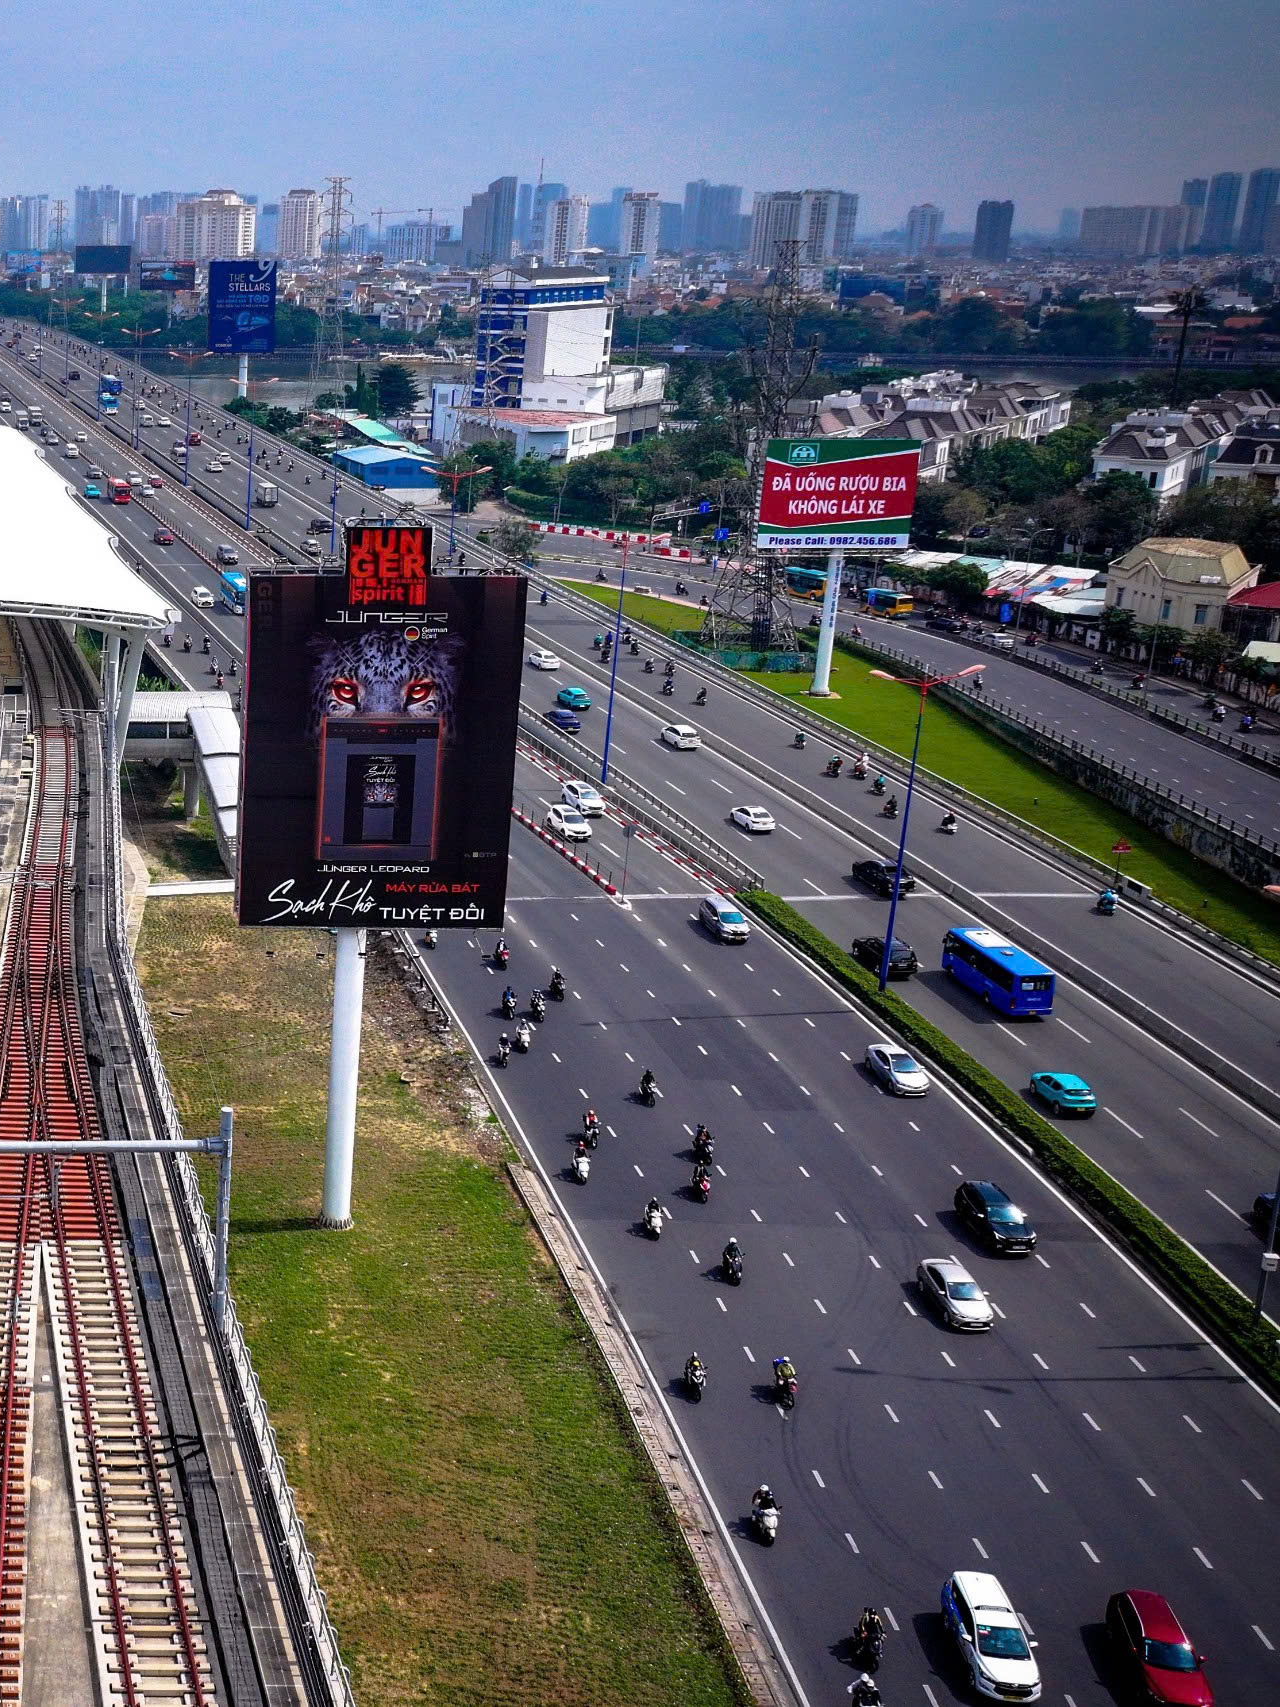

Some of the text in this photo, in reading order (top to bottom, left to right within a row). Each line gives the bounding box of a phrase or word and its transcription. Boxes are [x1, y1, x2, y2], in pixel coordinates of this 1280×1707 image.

[229, 258, 276, 282] THE 9
[228, 282, 271, 292] STELLARS
[772, 472, 906, 494] ĐÃ UỐNG RƯỢU BIA
[788, 495, 885, 515] KHÔNG LÁI XE
[768, 536, 897, 545] Please Call: 0982.456.686
[354, 585, 404, 605] spirit
[370, 864, 430, 873] LEOPARD
[385, 881, 481, 893] MÁY RỬA BÁT
[259, 878, 377, 923] Sạch Khô
[379, 902, 485, 923] TUYỆT ĐỐI
